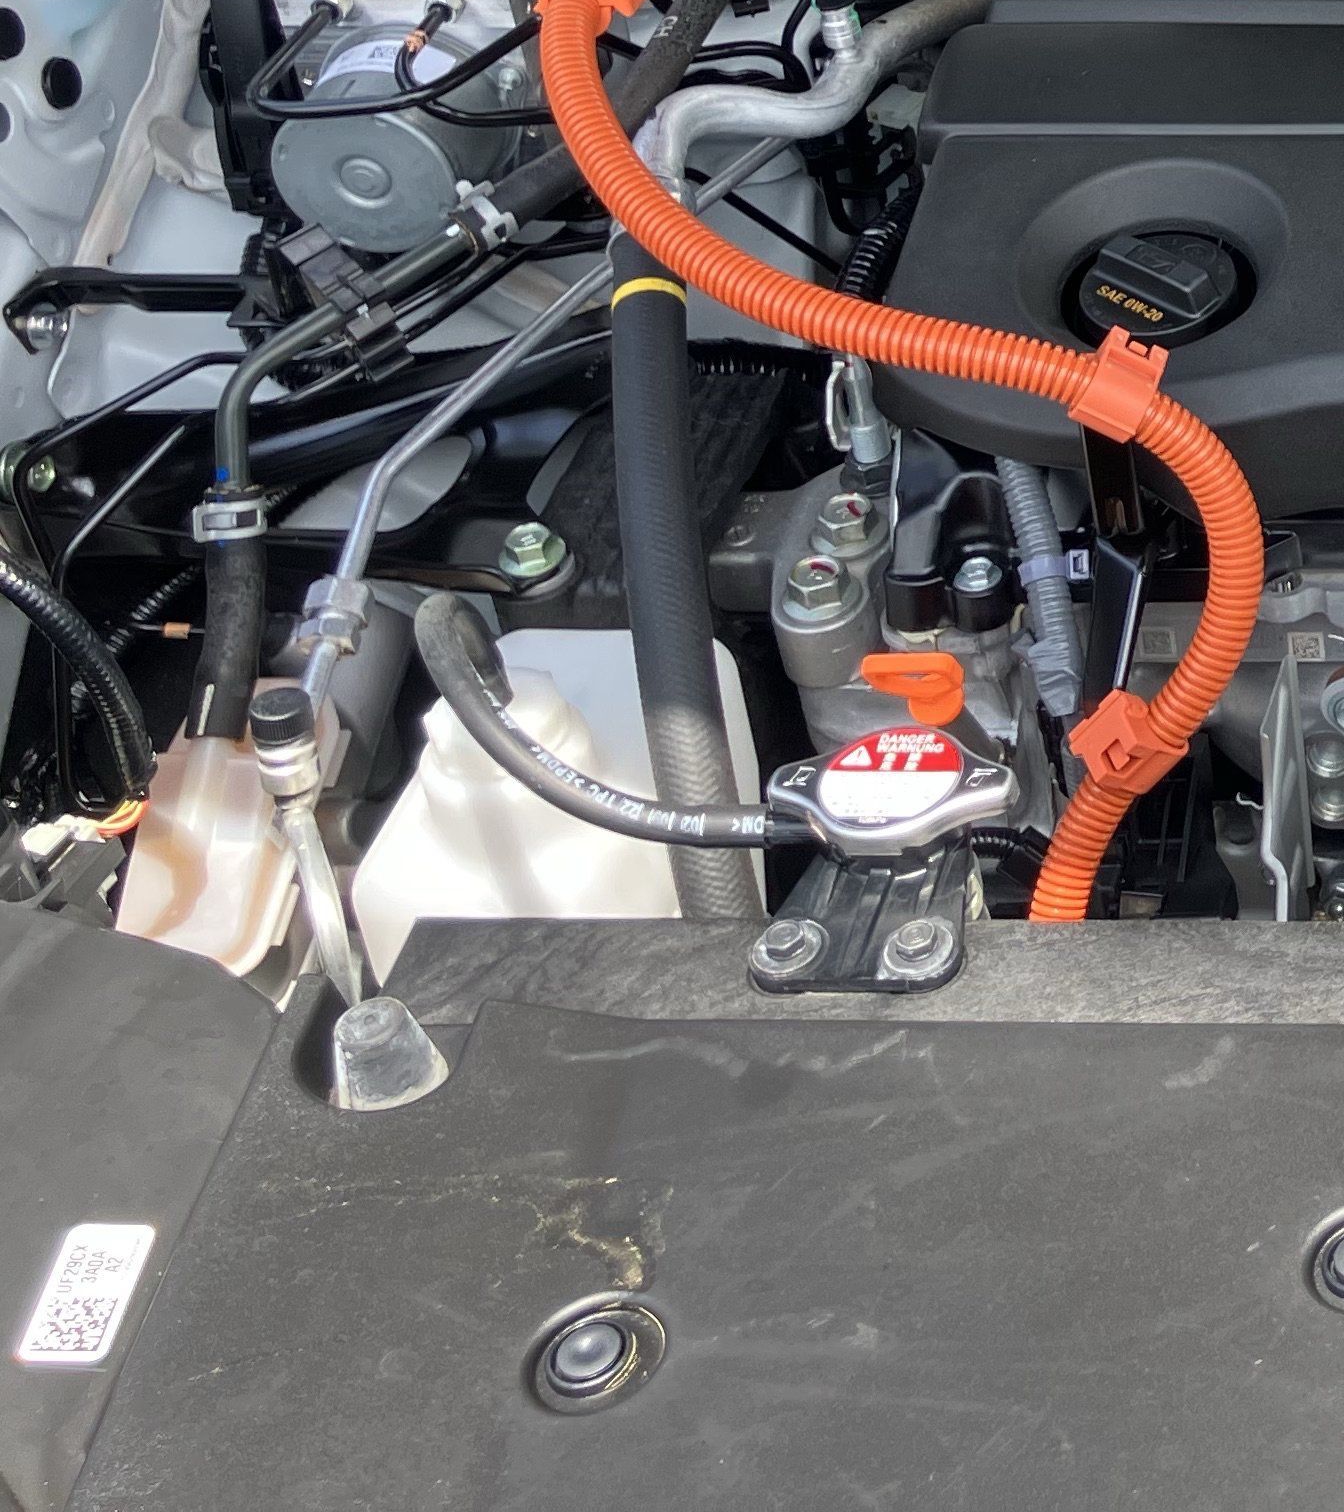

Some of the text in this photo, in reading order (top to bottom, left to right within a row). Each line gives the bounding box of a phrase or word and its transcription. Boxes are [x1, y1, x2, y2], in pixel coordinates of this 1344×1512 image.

[1096, 285, 1164, 322] SAE 0W-20
[879, 732, 936, 744] DANGER
[56, 1245, 88, 1293] UF29CX
[105, 1257, 124, 1273] A2
